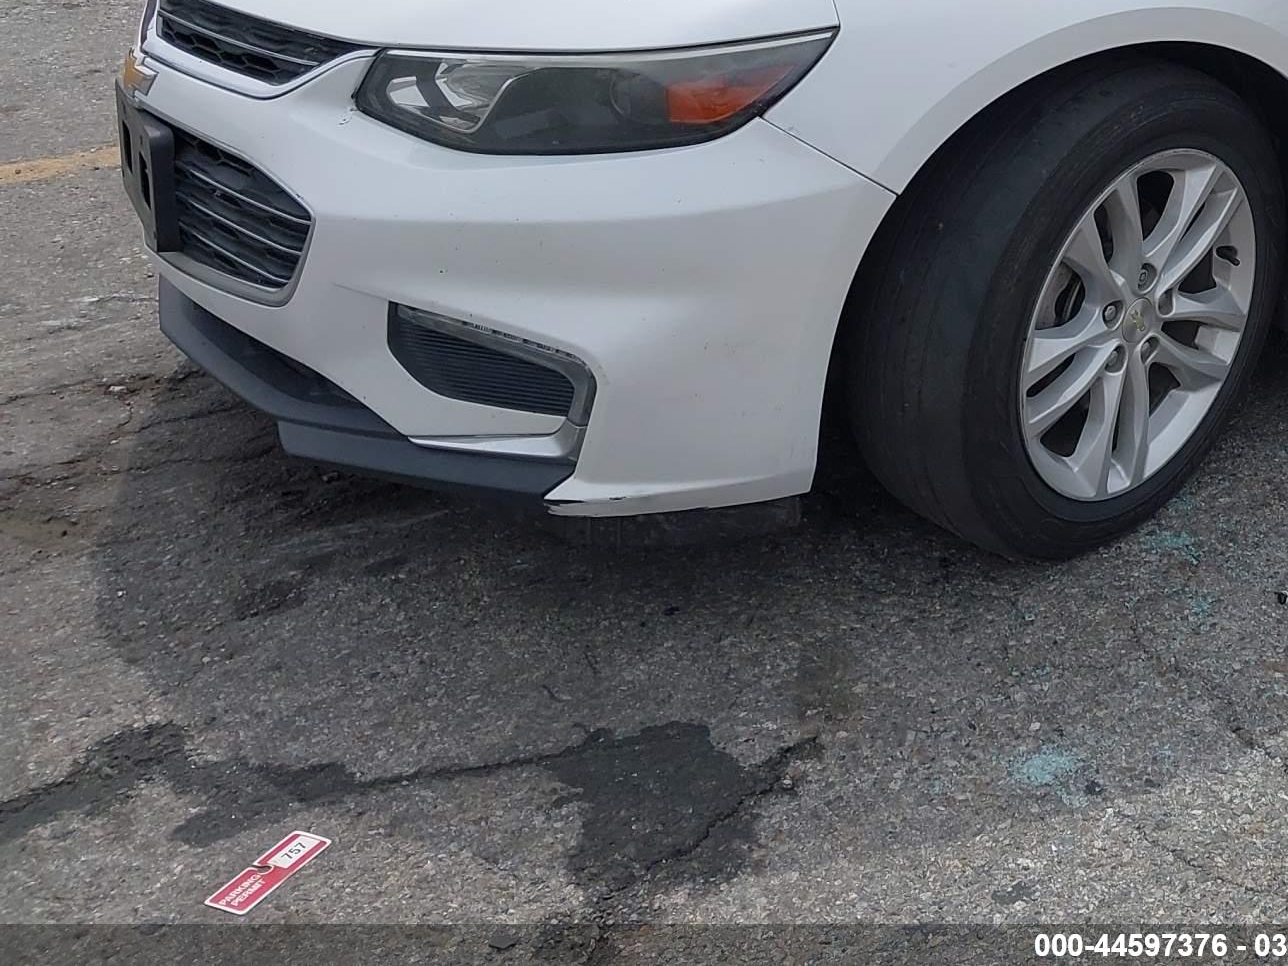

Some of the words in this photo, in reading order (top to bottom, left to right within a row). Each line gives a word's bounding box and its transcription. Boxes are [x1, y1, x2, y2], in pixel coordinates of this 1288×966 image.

[281, 842, 307, 860] 757
[218, 874, 262, 906] PARKING
[230, 878, 267, 907] PERMIT
